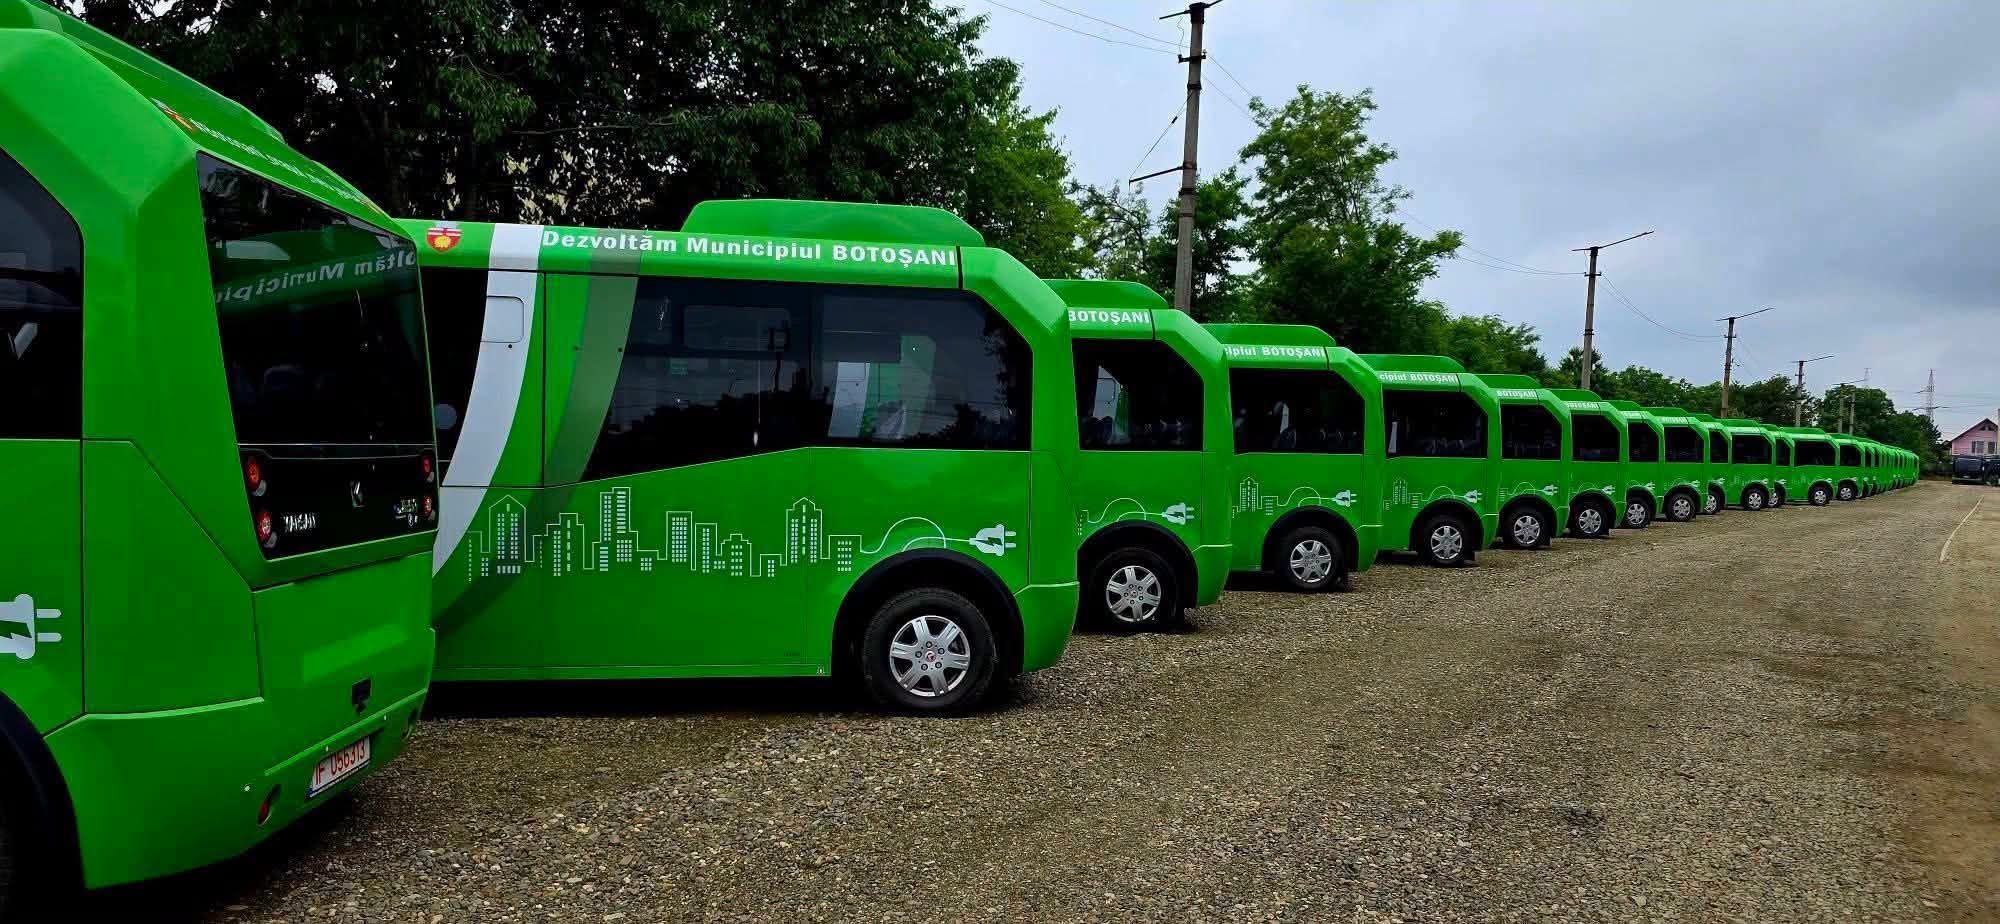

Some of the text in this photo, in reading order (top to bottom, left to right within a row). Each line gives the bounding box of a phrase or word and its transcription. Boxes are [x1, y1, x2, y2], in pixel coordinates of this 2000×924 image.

[542, 230, 956, 268] Dezvoltăm Municipiul BOTOȘANI
